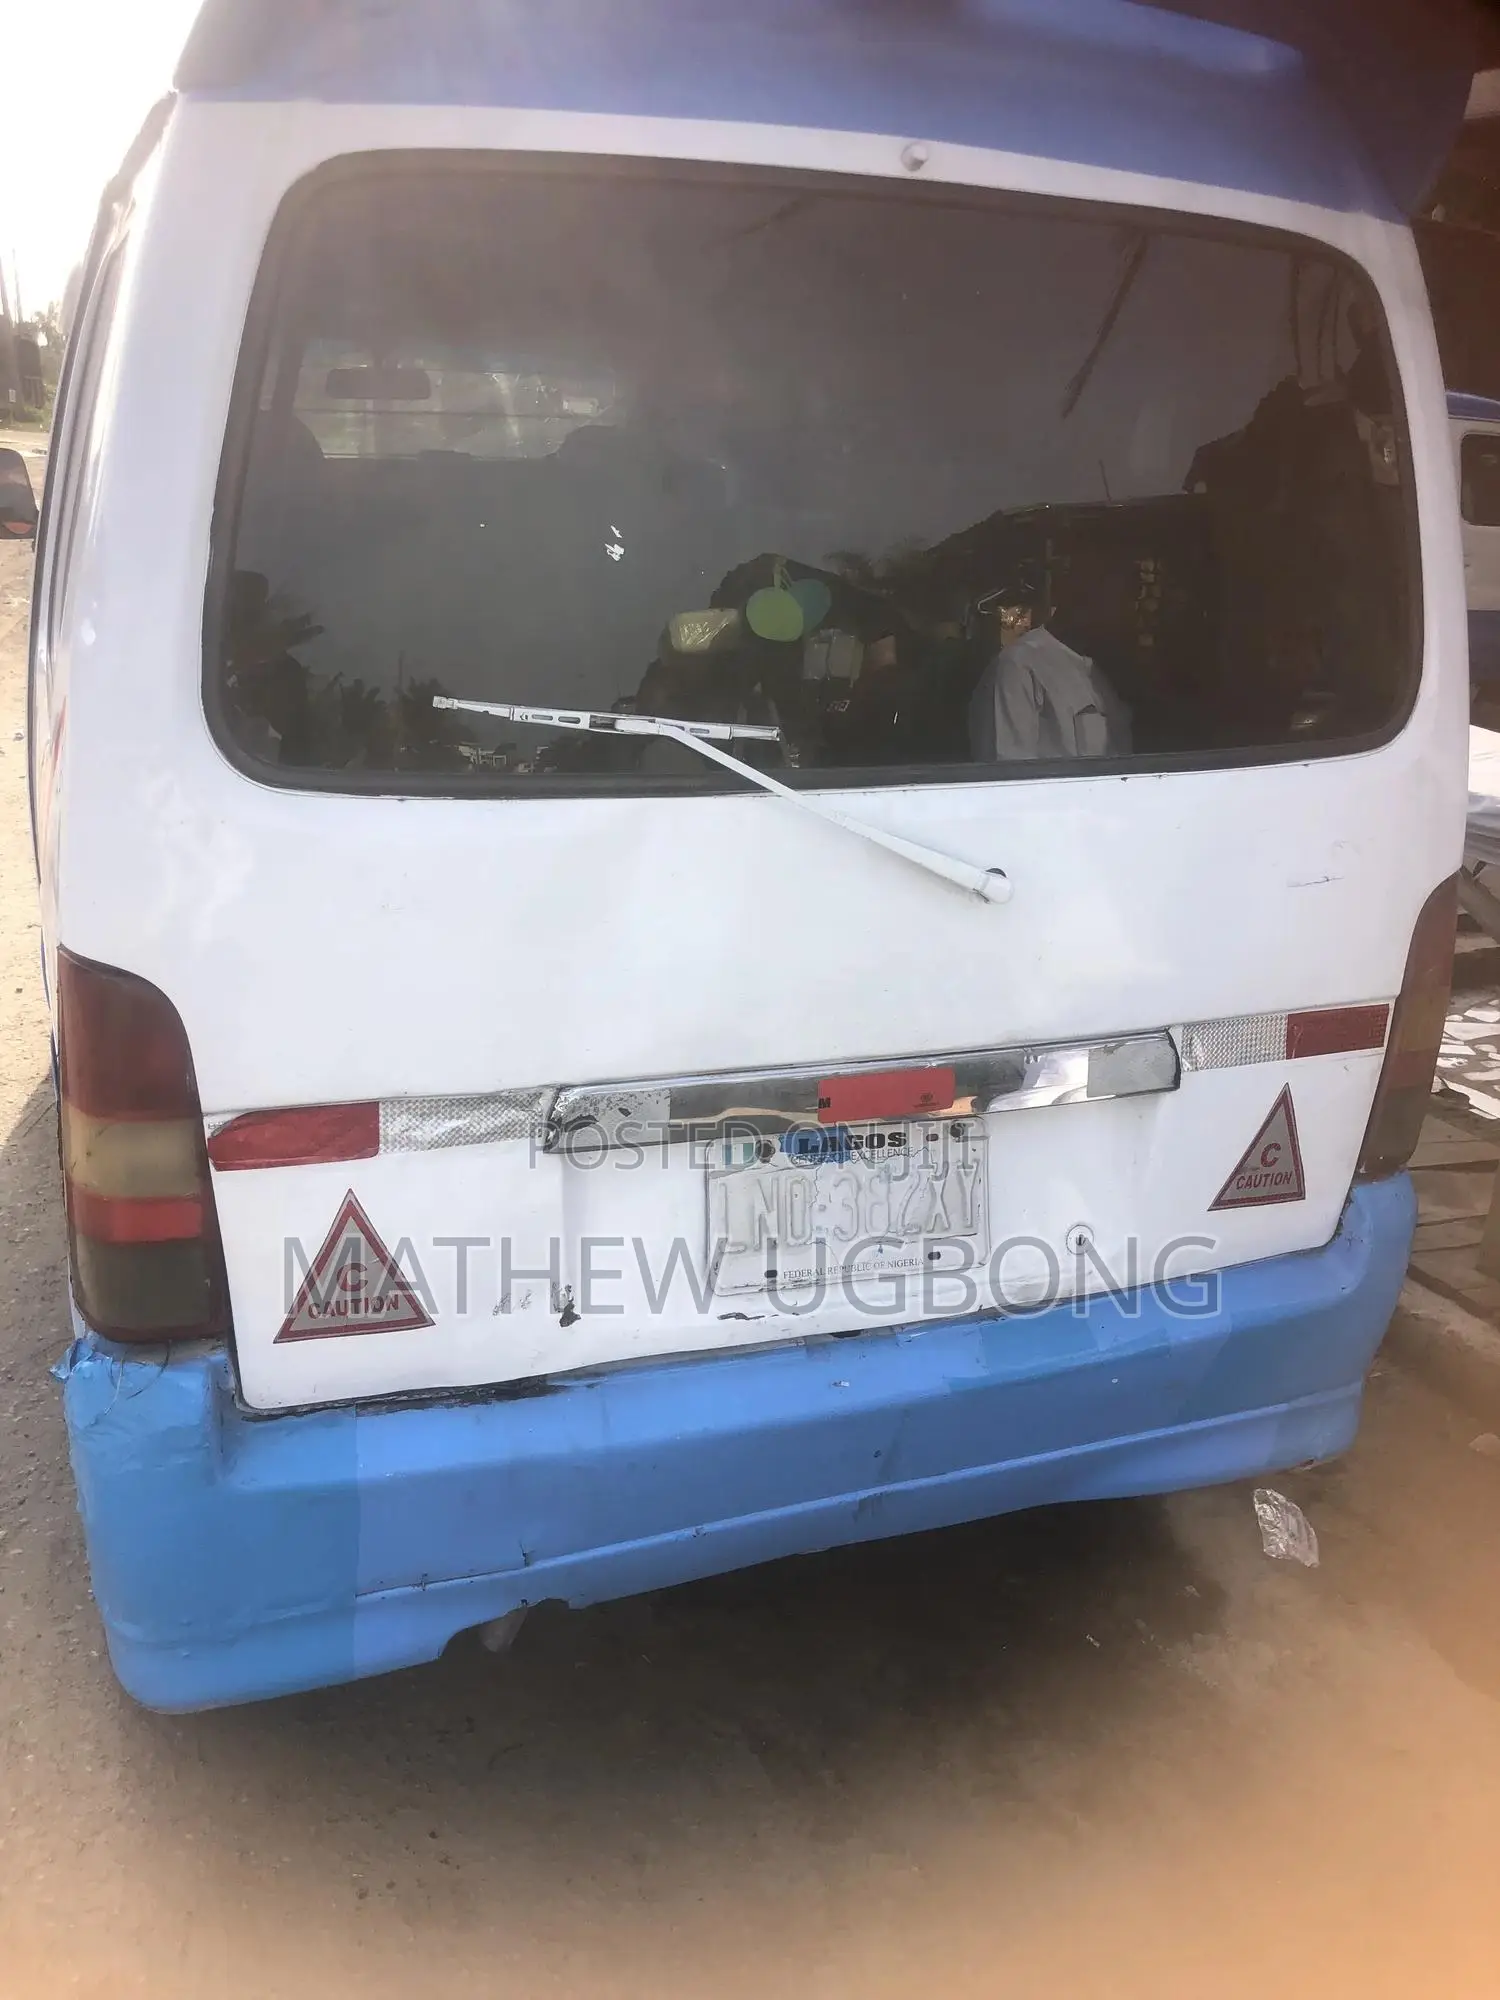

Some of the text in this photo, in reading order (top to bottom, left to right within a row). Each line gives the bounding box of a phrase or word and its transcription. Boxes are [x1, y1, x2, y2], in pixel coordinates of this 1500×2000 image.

[798, 1131, 907, 1154] LAGOS
[1260, 1142, 1282, 1168] C
[1236, 1171, 1293, 1190] CAUTION
[336, 1262, 368, 1292] C
[783, 1257, 924, 1280] FEDERAL REPUBLIC OF NIGERIA
[308, 1294, 399, 1319] CAUTION
